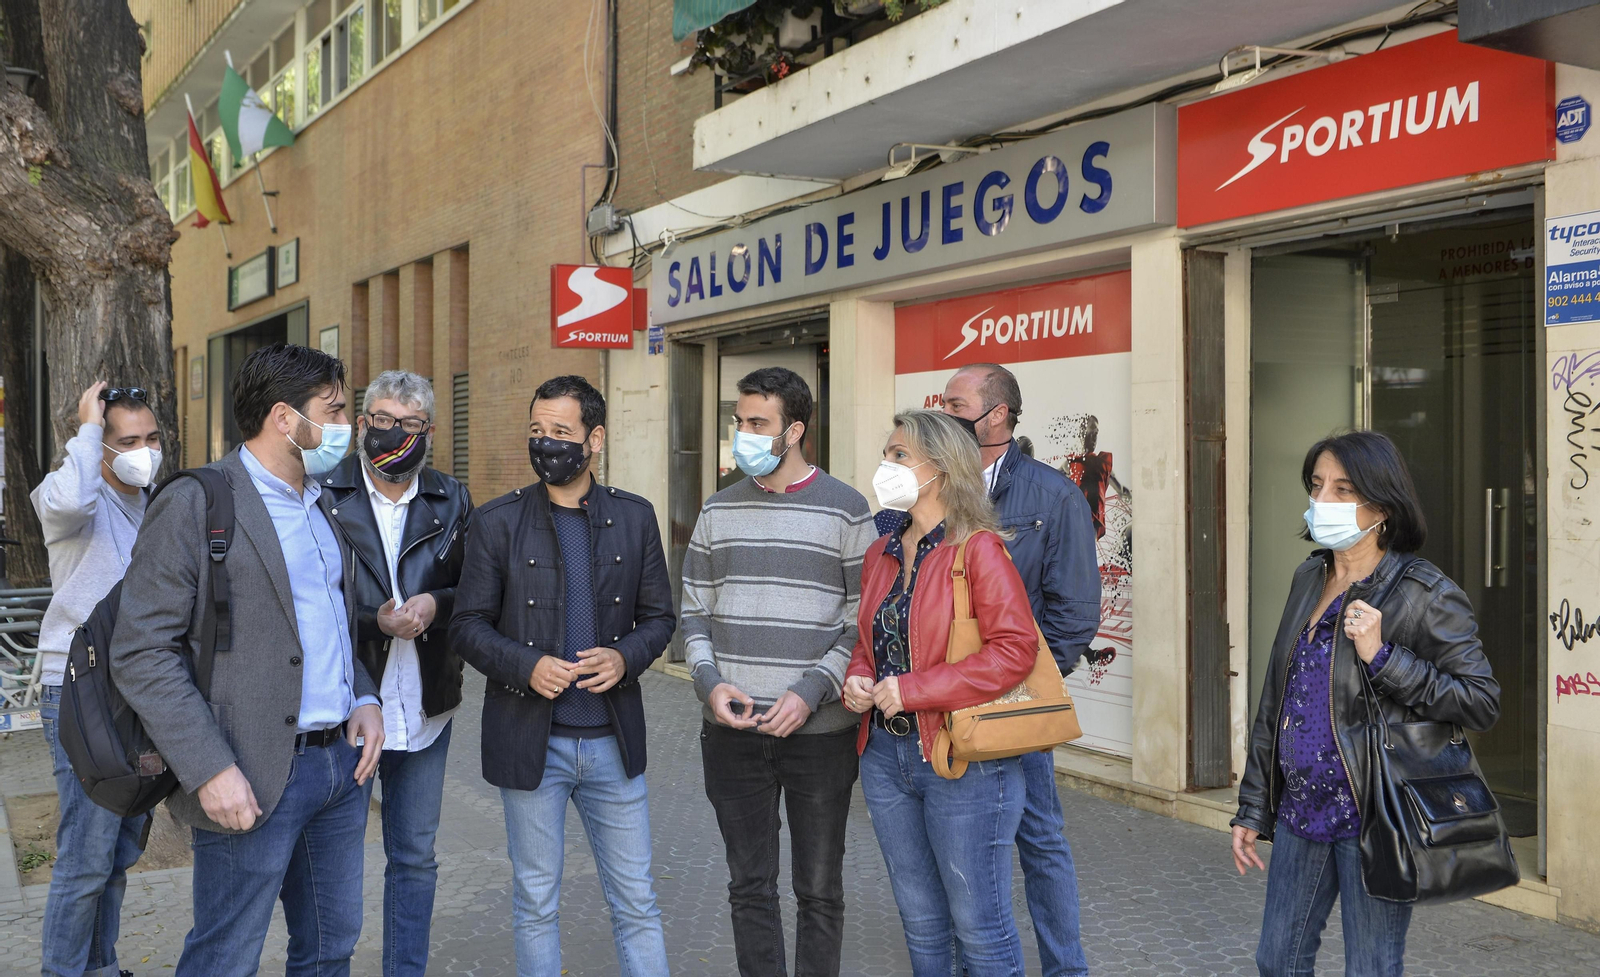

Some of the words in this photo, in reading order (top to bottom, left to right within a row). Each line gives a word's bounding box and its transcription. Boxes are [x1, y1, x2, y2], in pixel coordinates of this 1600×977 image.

[1557, 106, 1586, 129] ADT
[1215, 81, 1479, 192] SPORTIUM
[667, 233, 782, 308] SALON
[804, 212, 855, 276] DE
[873, 141, 1113, 261] JUEGOS
[1548, 222, 1600, 244] tyco
[1440, 239, 1515, 261] PROHIBIDA
[1439, 268, 1447, 280] A
[1452, 258, 1518, 278] MENORES
[1564, 281, 1584, 290] aviso
[1548, 295, 1568, 308] 902
[1571, 292, 1592, 305] 444
[560, 329, 628, 344] SPORTIUM
[943, 304, 1093, 360] SPORTIUM
